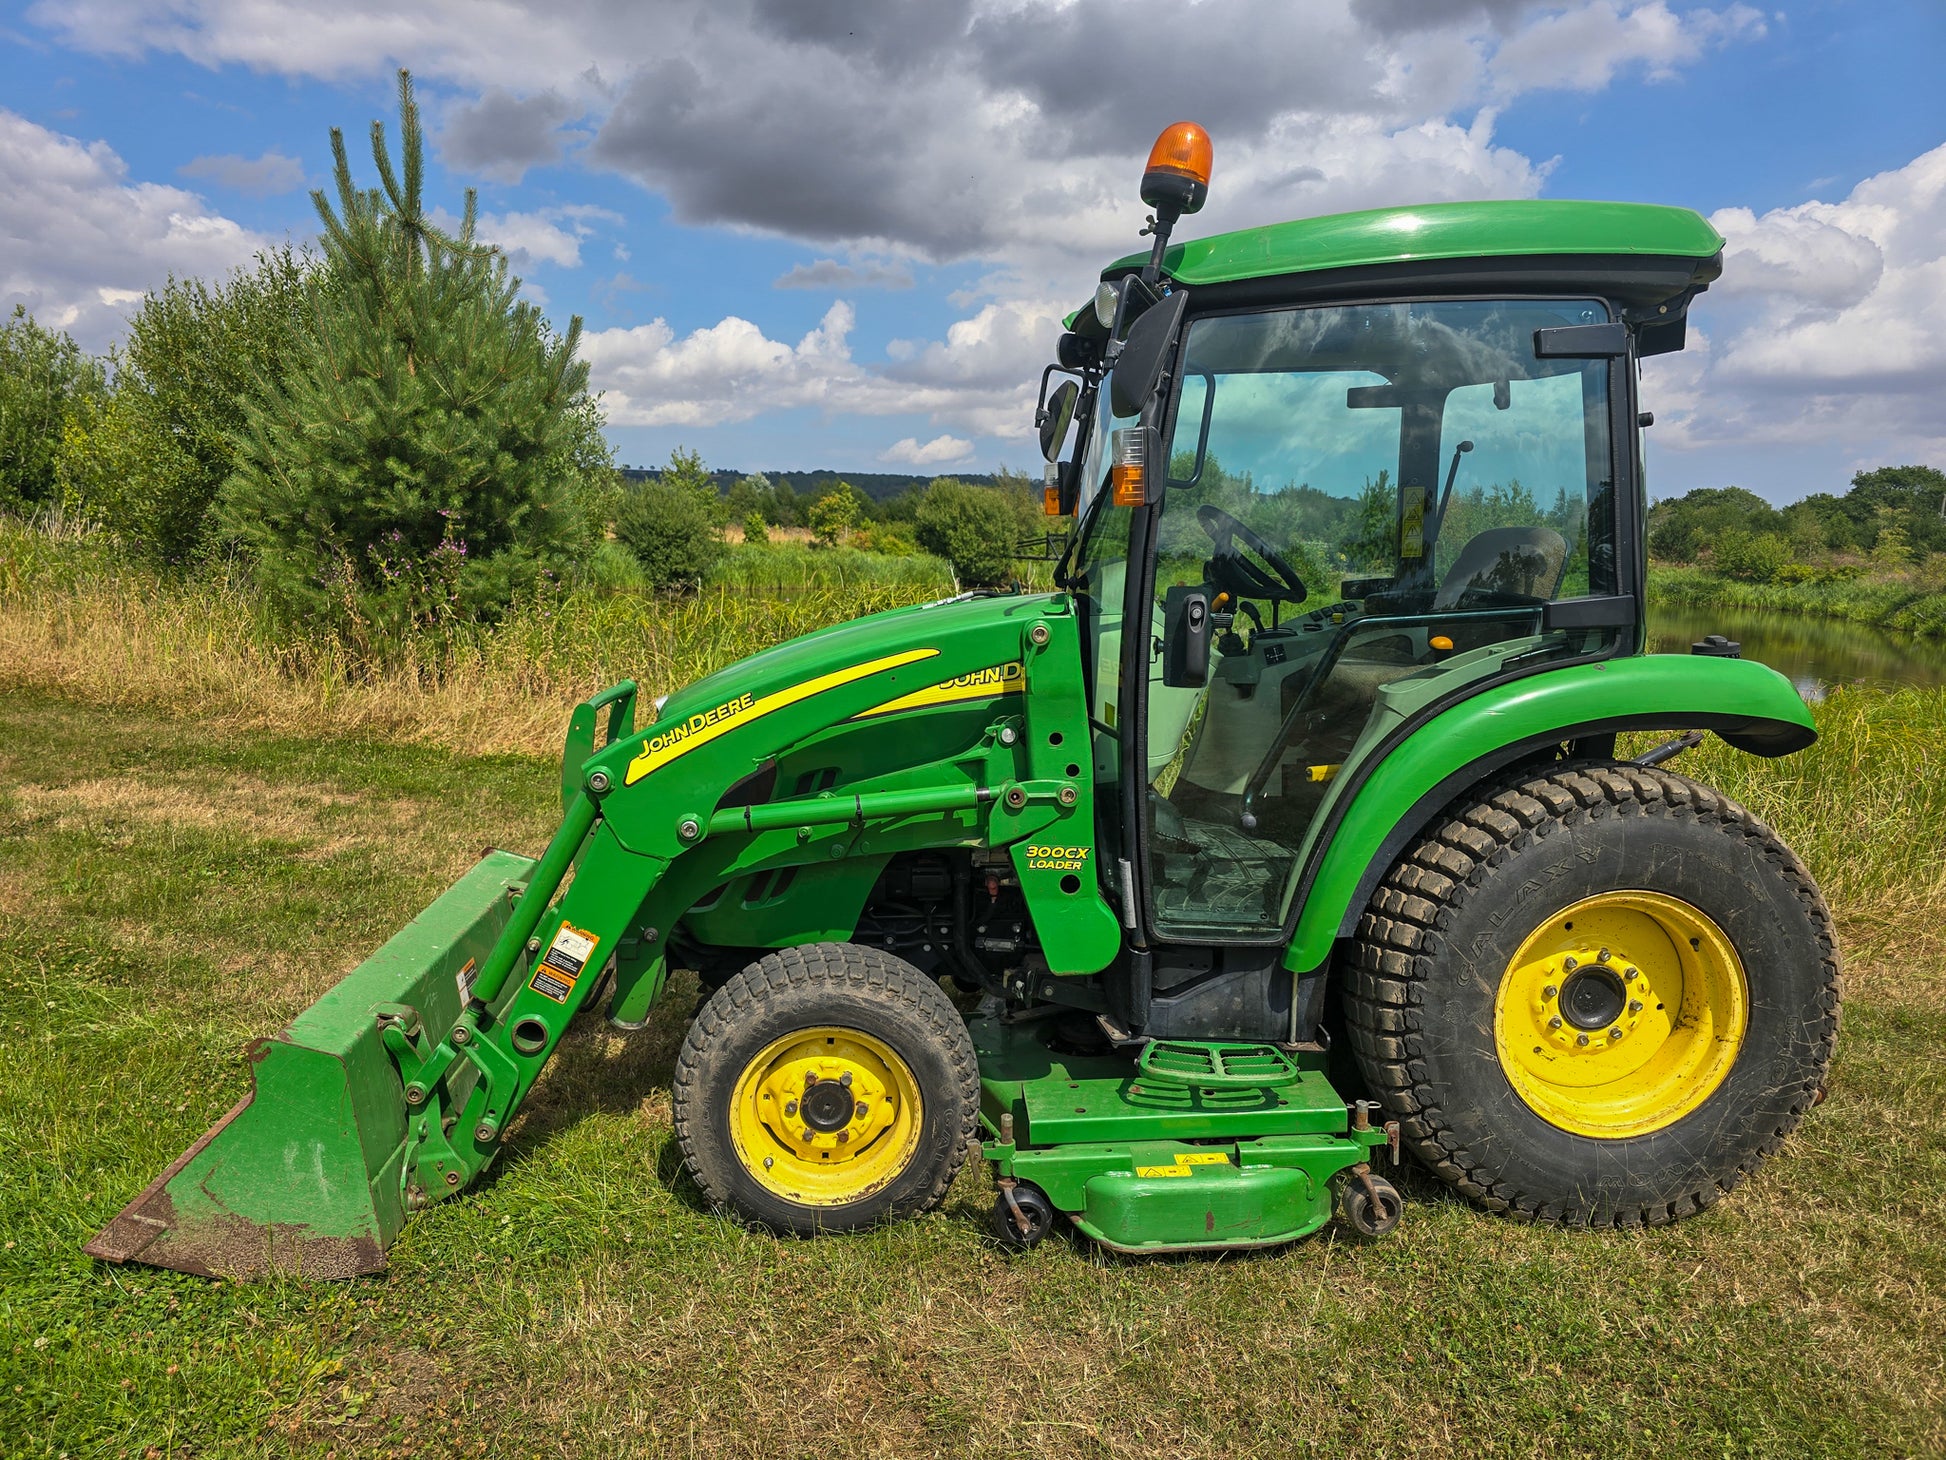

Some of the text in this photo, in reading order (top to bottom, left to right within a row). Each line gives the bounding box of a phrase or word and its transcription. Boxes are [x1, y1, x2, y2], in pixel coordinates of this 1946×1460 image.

[638, 692, 755, 759] JOHN DEERE
[1026, 845, 1090, 860] 300CX
[1029, 859, 1082, 870] LOADER
[1456, 846, 1603, 987] GALAXY
